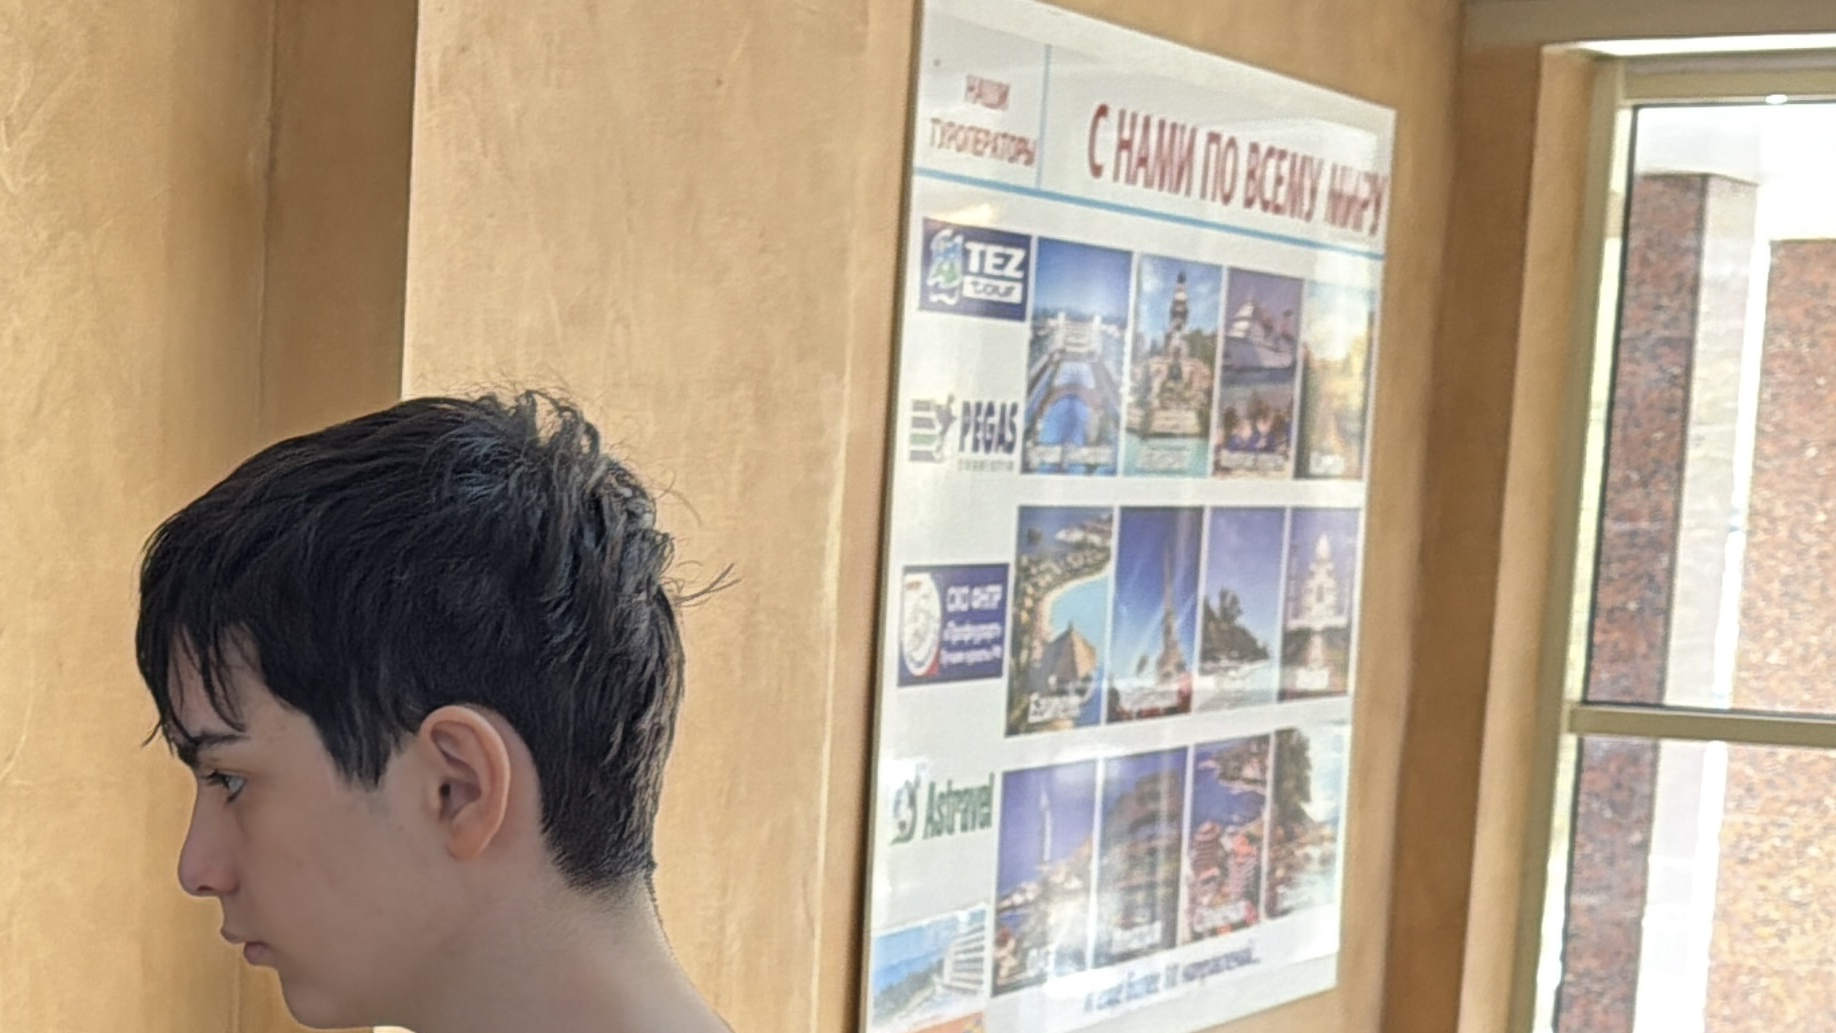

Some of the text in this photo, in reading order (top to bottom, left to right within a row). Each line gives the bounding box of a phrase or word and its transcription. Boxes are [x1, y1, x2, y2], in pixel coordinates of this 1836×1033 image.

[1112, 109, 1198, 198] НАМИ
[1199, 131, 1239, 206] ПО
[1243, 141, 1324, 223] ВСЕМУ
[964, 241, 1026, 279] TEZ
[959, 400, 1019, 455] PEGAS
